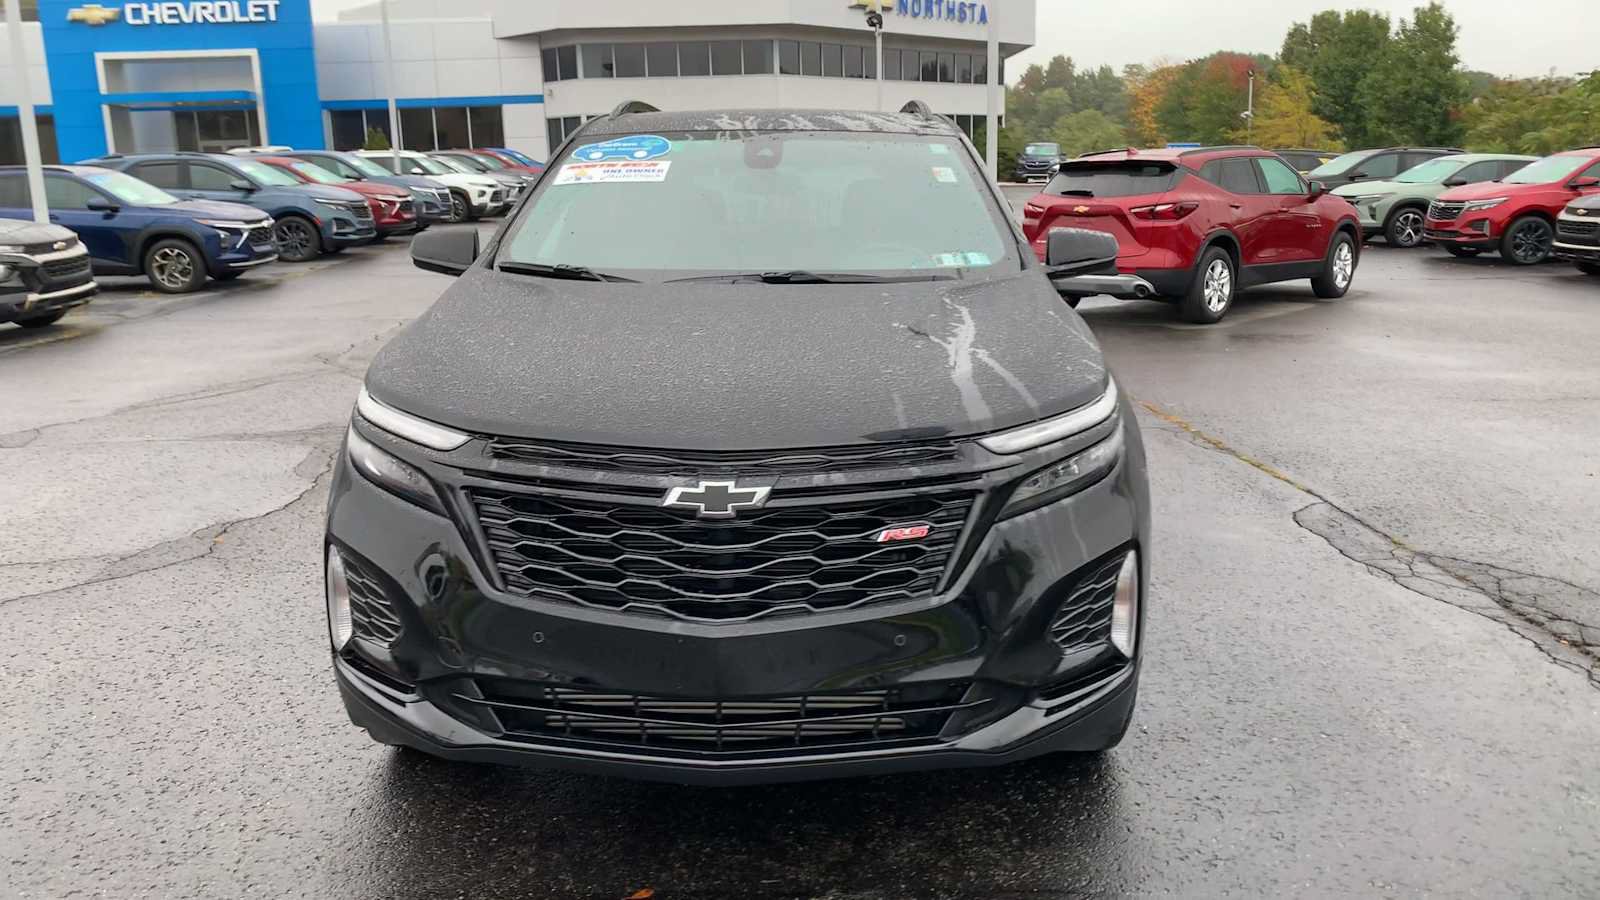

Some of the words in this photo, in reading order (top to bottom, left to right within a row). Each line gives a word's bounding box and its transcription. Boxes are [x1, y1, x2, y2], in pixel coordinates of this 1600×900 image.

[124, 1, 280, 25] CHEVROLET
[896, 0, 989, 25] NORTHSTA
[880, 525, 929, 542] RS
